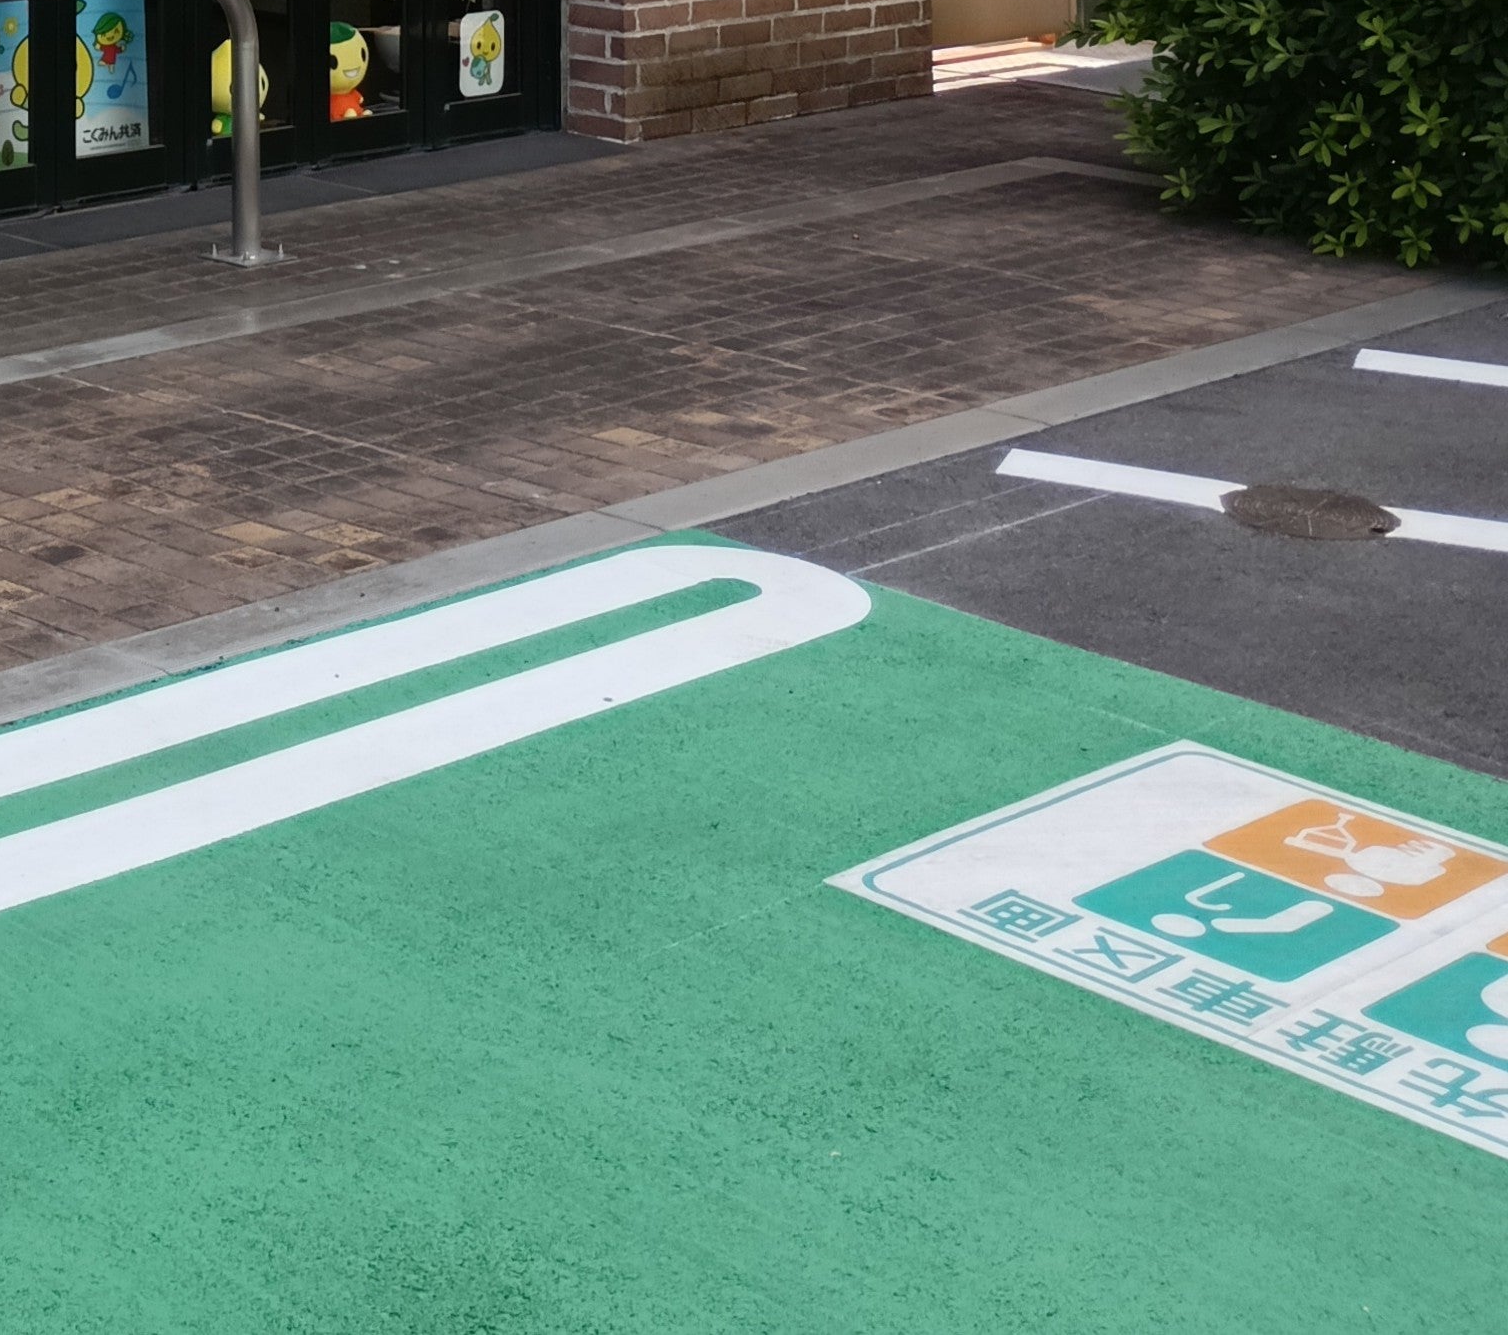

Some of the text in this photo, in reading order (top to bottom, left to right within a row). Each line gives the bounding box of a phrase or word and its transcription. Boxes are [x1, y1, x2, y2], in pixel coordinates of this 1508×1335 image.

[83, 122, 142, 144] こくみん共済
